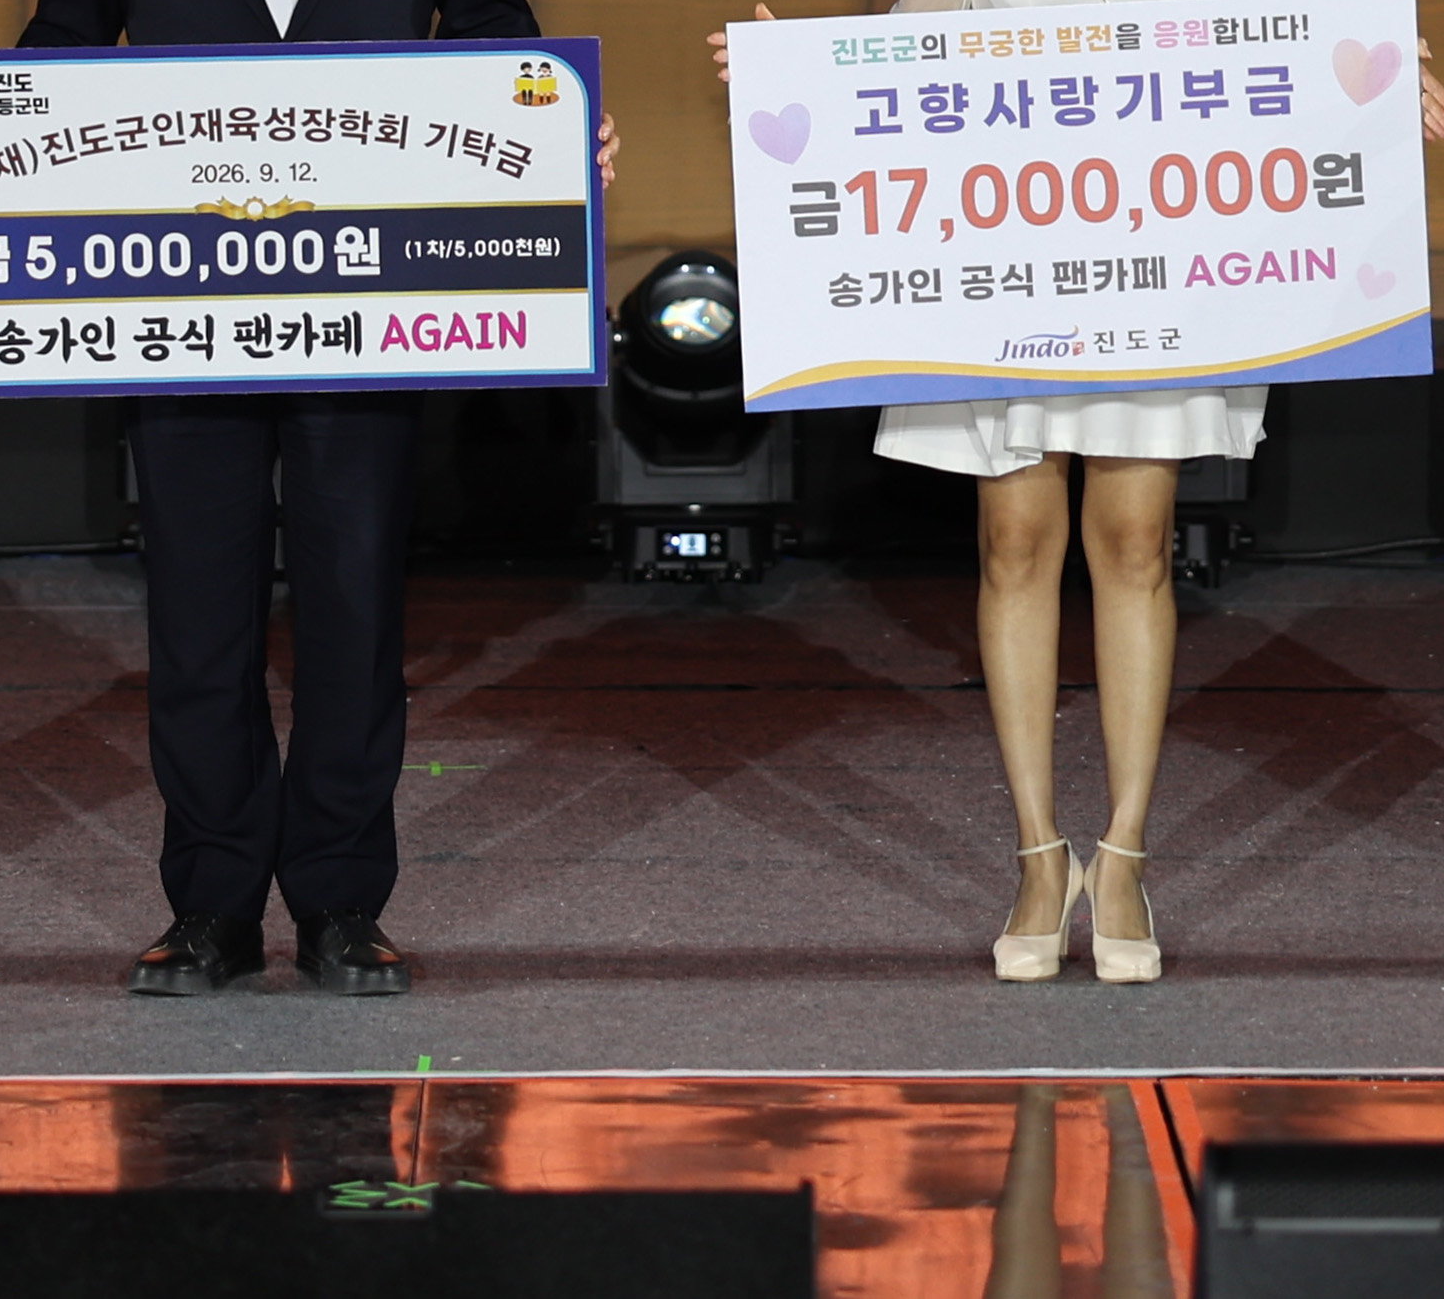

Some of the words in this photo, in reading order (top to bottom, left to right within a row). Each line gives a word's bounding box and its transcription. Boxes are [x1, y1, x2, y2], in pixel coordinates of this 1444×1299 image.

[831, 32, 948, 66] 진도군의
[959, 27, 1045, 60] 무궁한
[1055, 22, 1142, 54] 발전을
[1153, 14, 1310, 49] 응원합니다!
[854, 65, 1294, 135] 고향사랑기부금
[191, 164, 250, 184] 2026.
[259, 163, 280, 184] 9.
[289, 162, 318, 183] 12.
[423, 120, 535, 179] 기탁금
[789, 146, 1366, 243] 금17,000,000원
[405, 237, 561, 259] (1차/5,000천원)
[828, 268, 943, 308] 송가인
[960, 263, 1036, 300] 공식
[1051, 255, 1168, 296] 팬카페
[1184, 247, 1337, 289] AGAIN
[133, 315, 216, 362] 공식
[233, 311, 364, 359] 팬카페
[380, 310, 528, 354] AGAIN
[995, 335, 1070, 362] Jindo
[1093, 328, 1182, 354] 진도군
